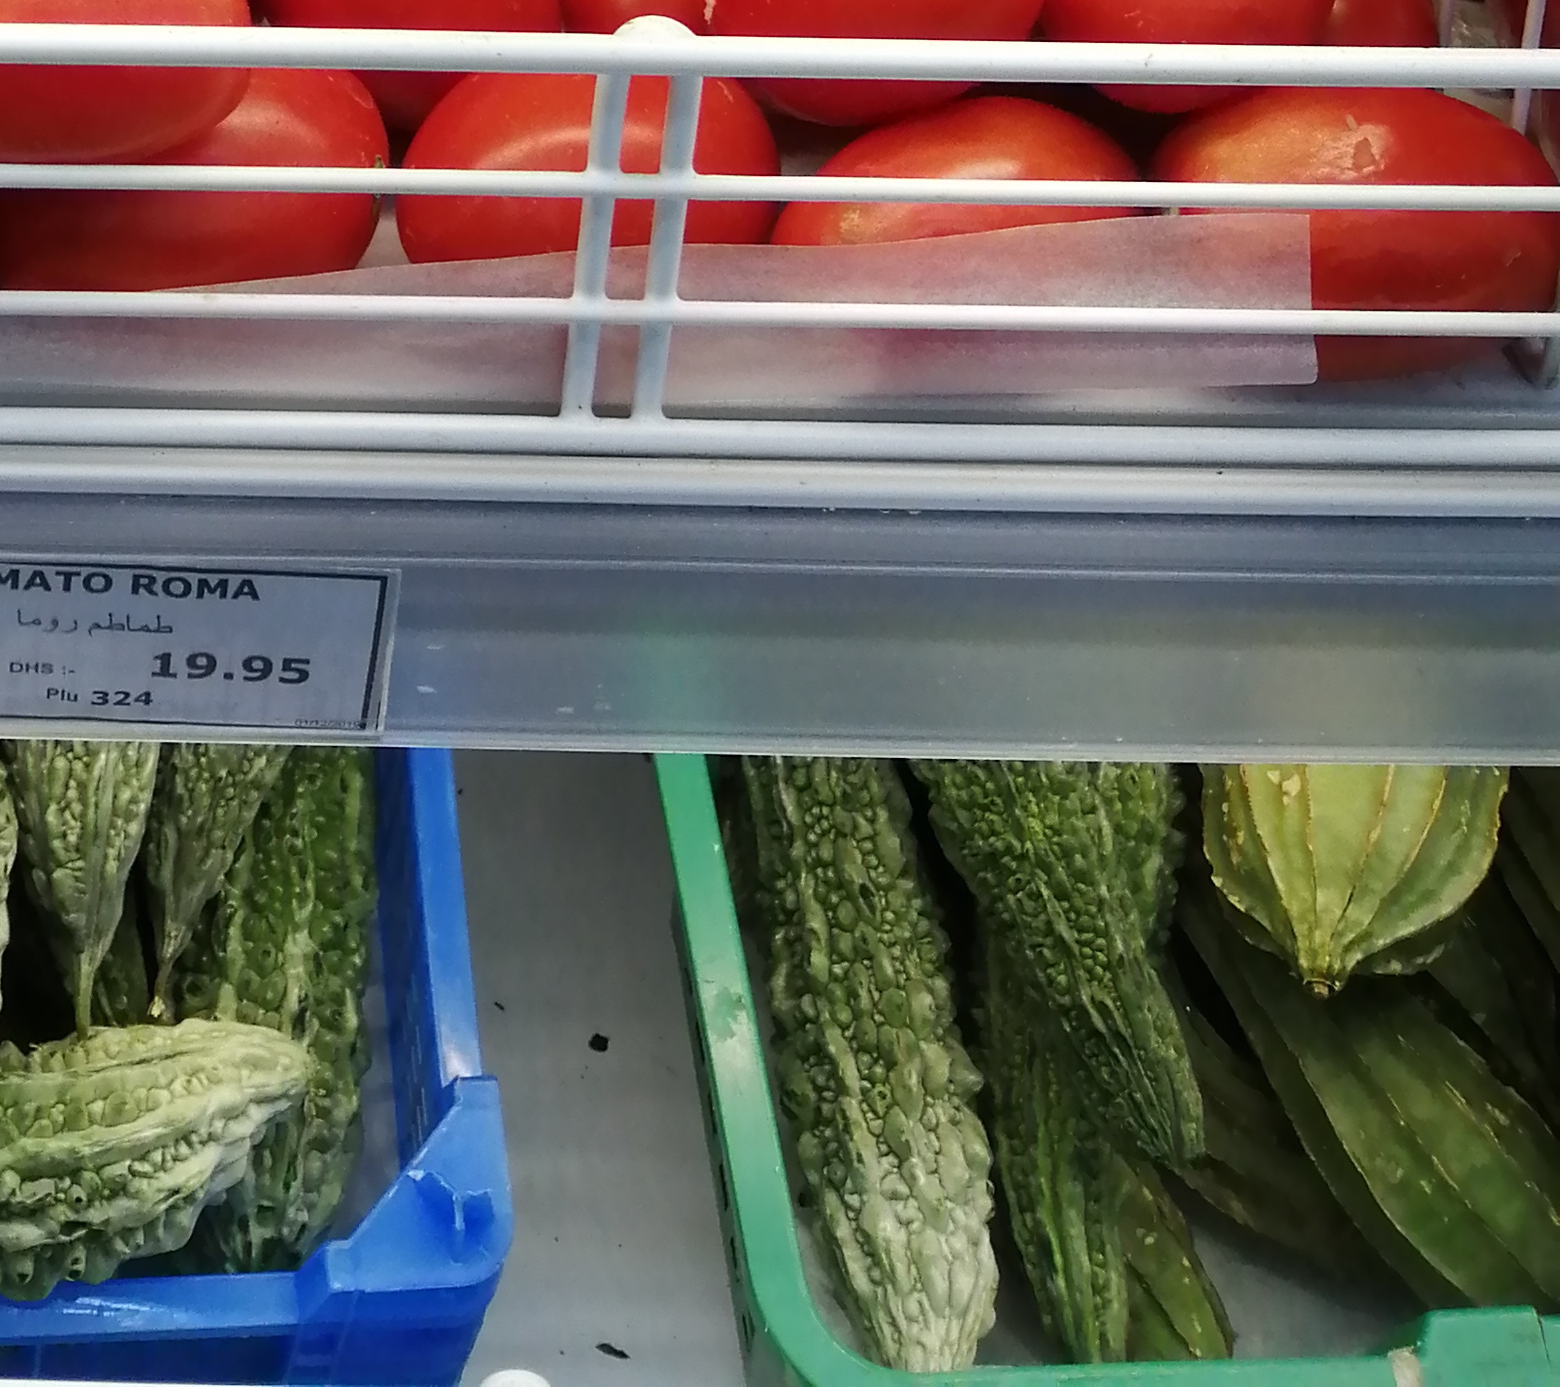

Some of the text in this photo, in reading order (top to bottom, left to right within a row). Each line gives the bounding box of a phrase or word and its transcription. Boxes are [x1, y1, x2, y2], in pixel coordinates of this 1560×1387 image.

[130, 574, 260, 602] ROMA
[16, 608, 174, 637] طماطم روما
[8, 661, 54, 675] DHS
[150, 651, 311, 685] 19.95
[45, 687, 154, 707] Plu 324
